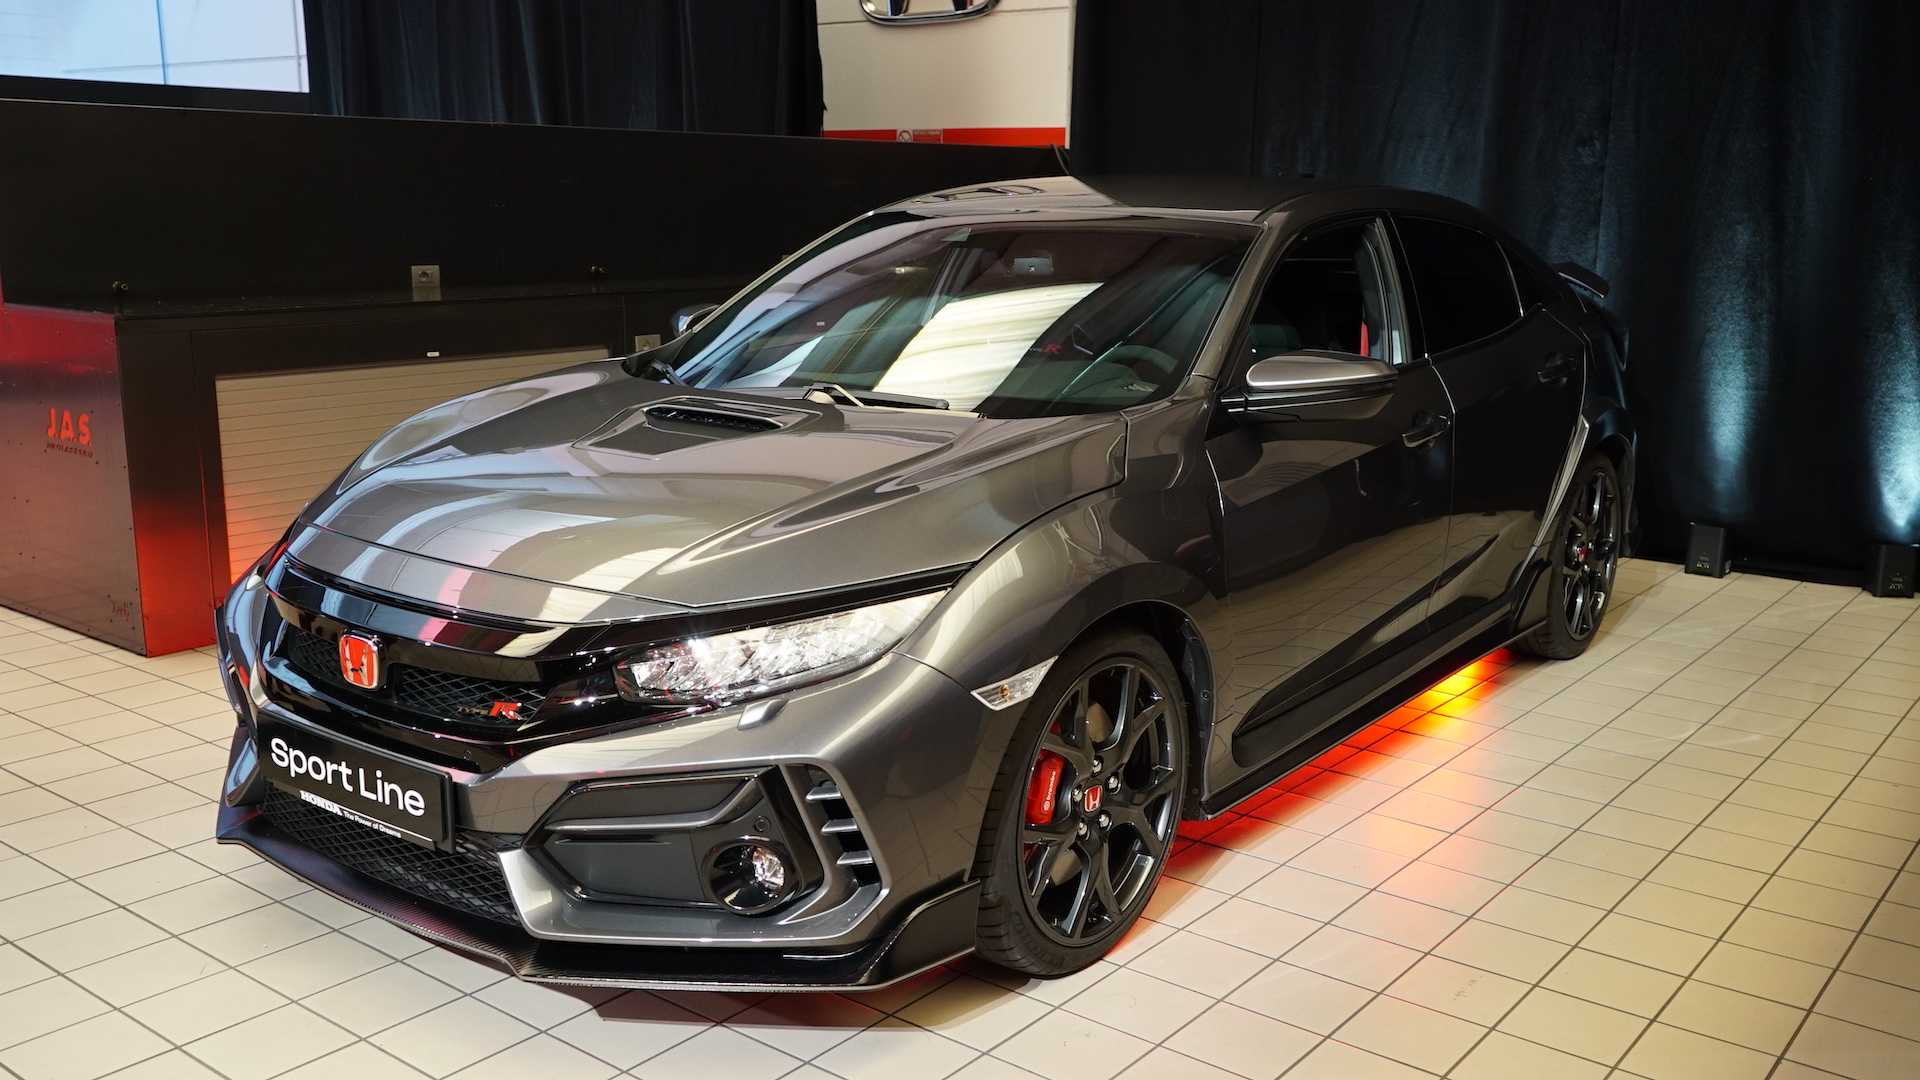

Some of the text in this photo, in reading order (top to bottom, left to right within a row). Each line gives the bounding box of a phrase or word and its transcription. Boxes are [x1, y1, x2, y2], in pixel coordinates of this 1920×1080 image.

[270, 737, 426, 817] Sport Line
[300, 790, 343, 816] HONDA
